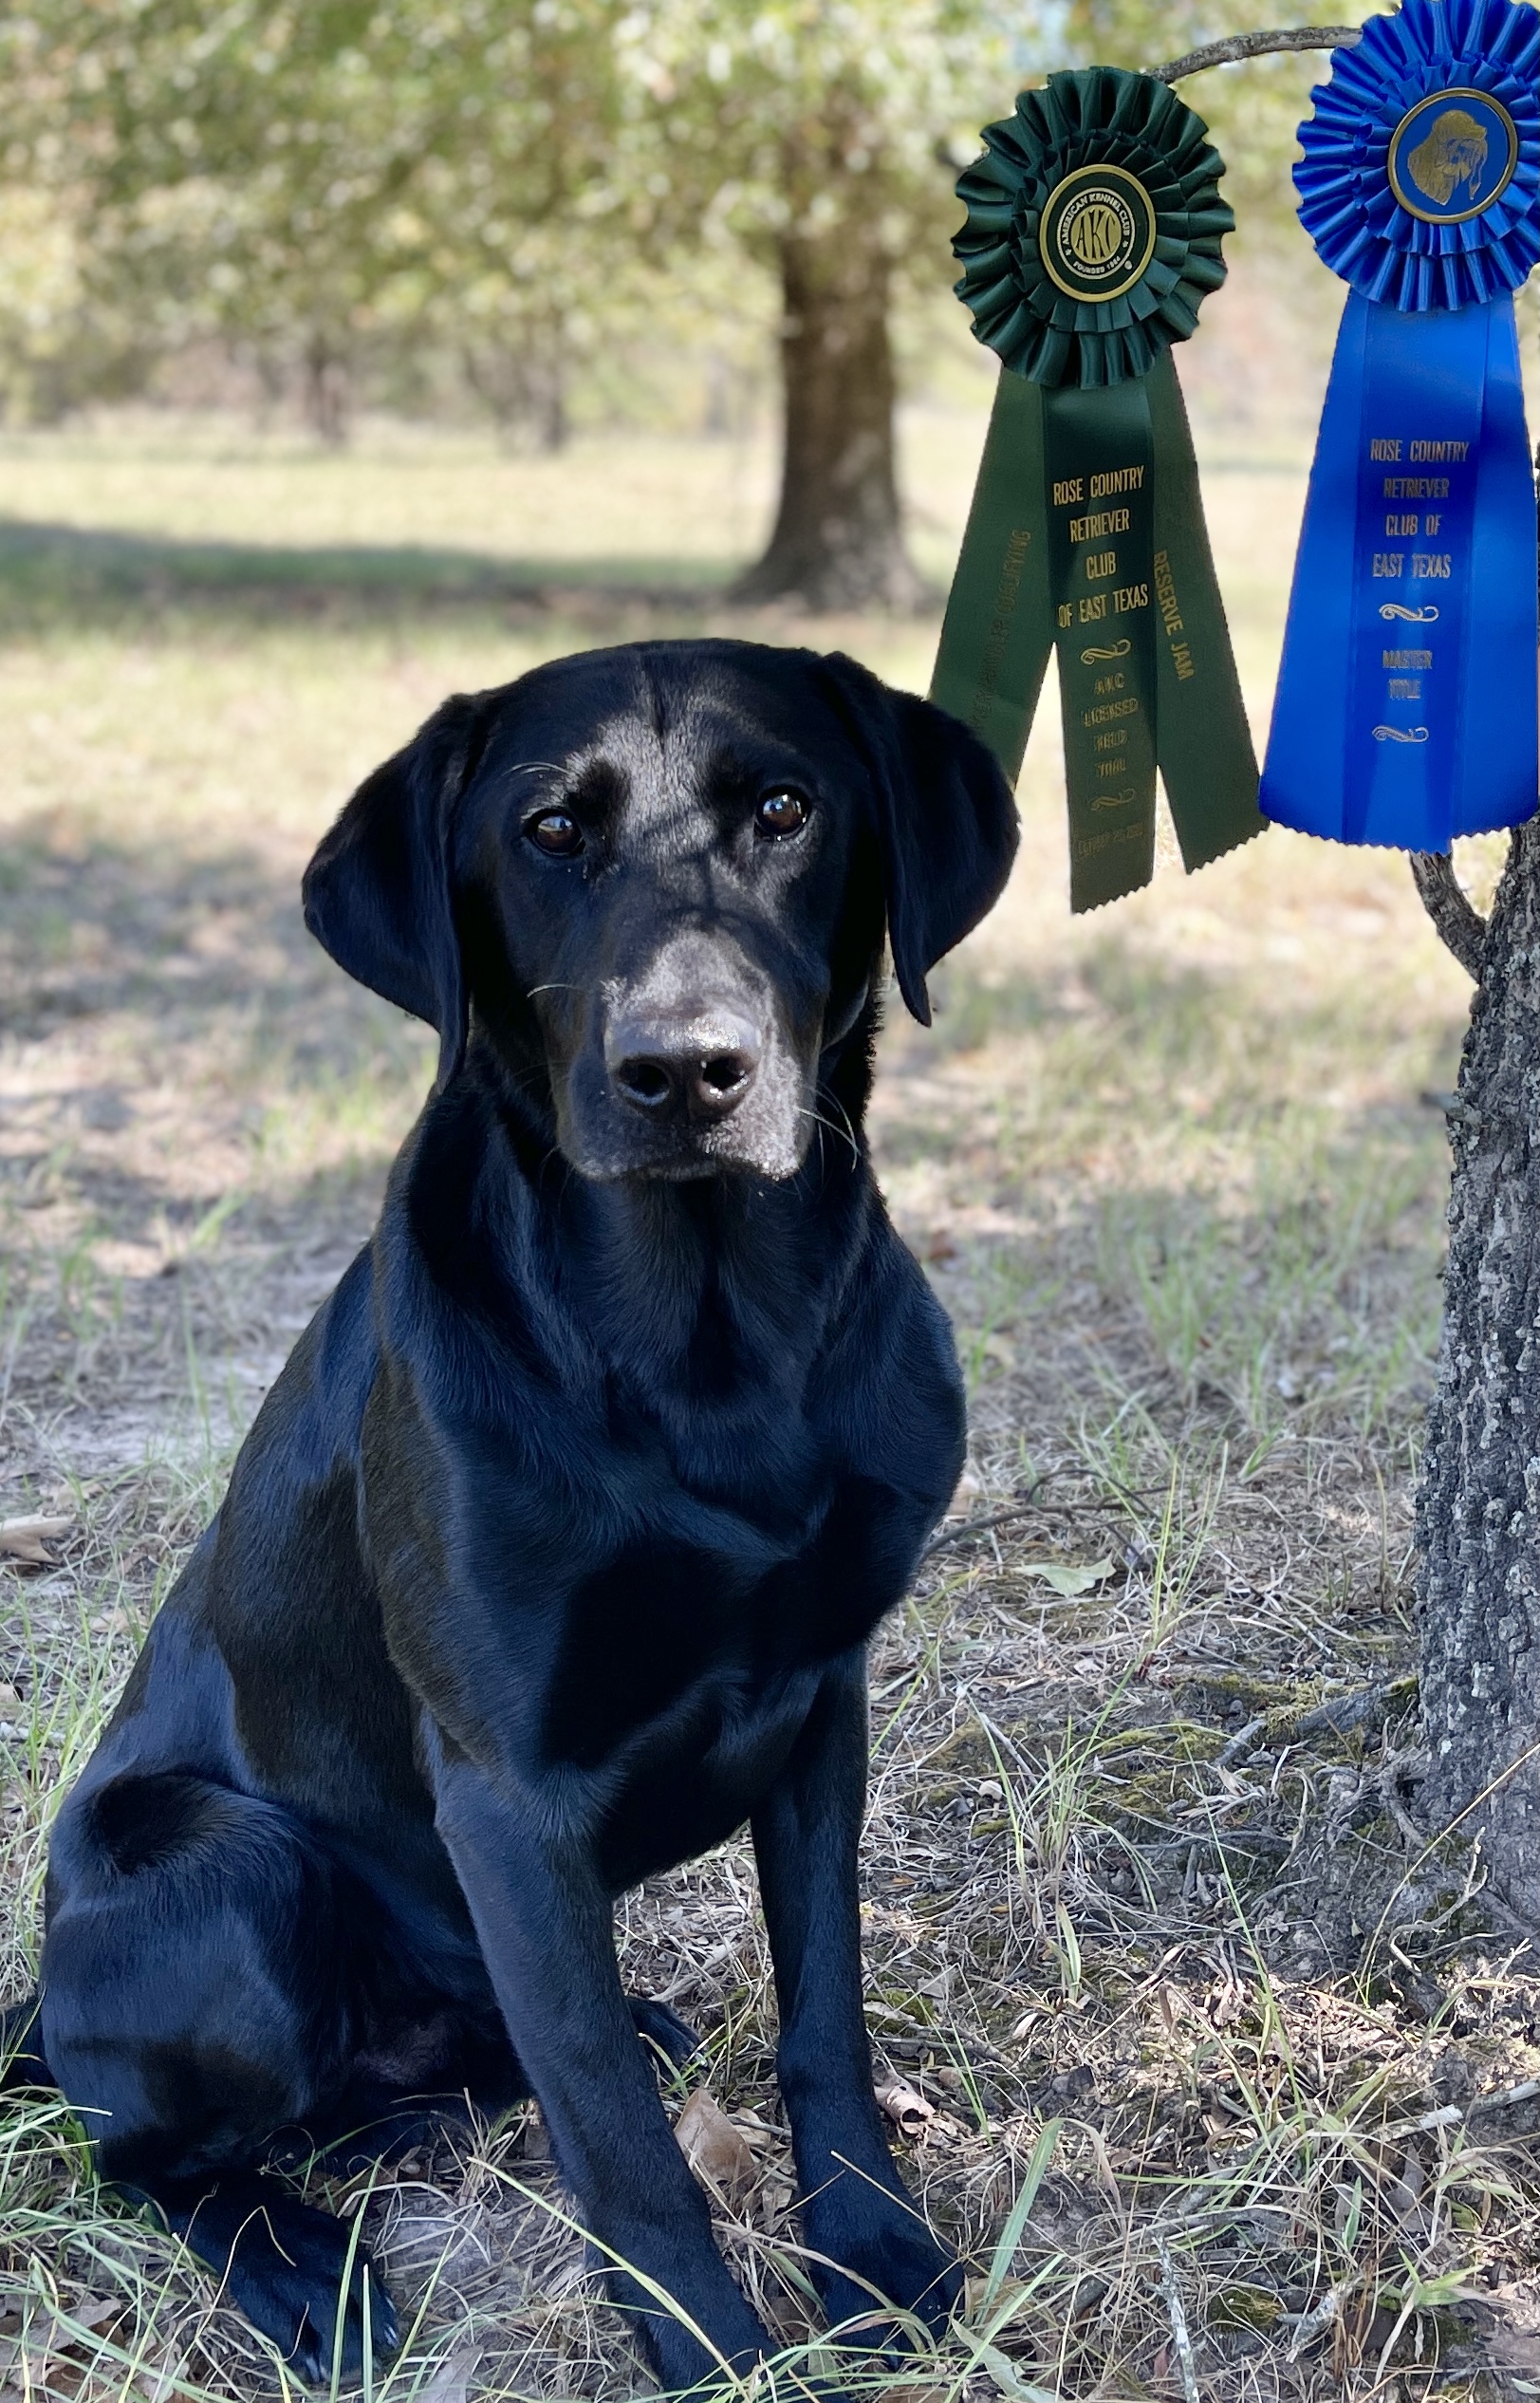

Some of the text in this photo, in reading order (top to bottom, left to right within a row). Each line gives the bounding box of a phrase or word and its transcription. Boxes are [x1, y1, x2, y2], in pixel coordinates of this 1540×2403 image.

[1061, 193, 1131, 246] AMERICAN KENNEL CLUB
[1076, 208, 1116, 260] AKC
[1072, 260, 1105, 275] FOUNDED
[1369, 438, 1470, 463] ROSE COUNTRY
[1053, 464, 1144, 506] ROSE COUNTRY
[1383, 477, 1450, 499] RETRIEVER
[1069, 508, 1130, 543] RETRIEVER
[1386, 514, 1442, 537] CLUB OF
[1085, 551, 1117, 580] CLUB
[1372, 553, 1452, 579] EAST TEXAS
[1058, 583, 1149, 628] OF EAST TEXAS
[1153, 549, 1196, 680] RESERVE JAM
